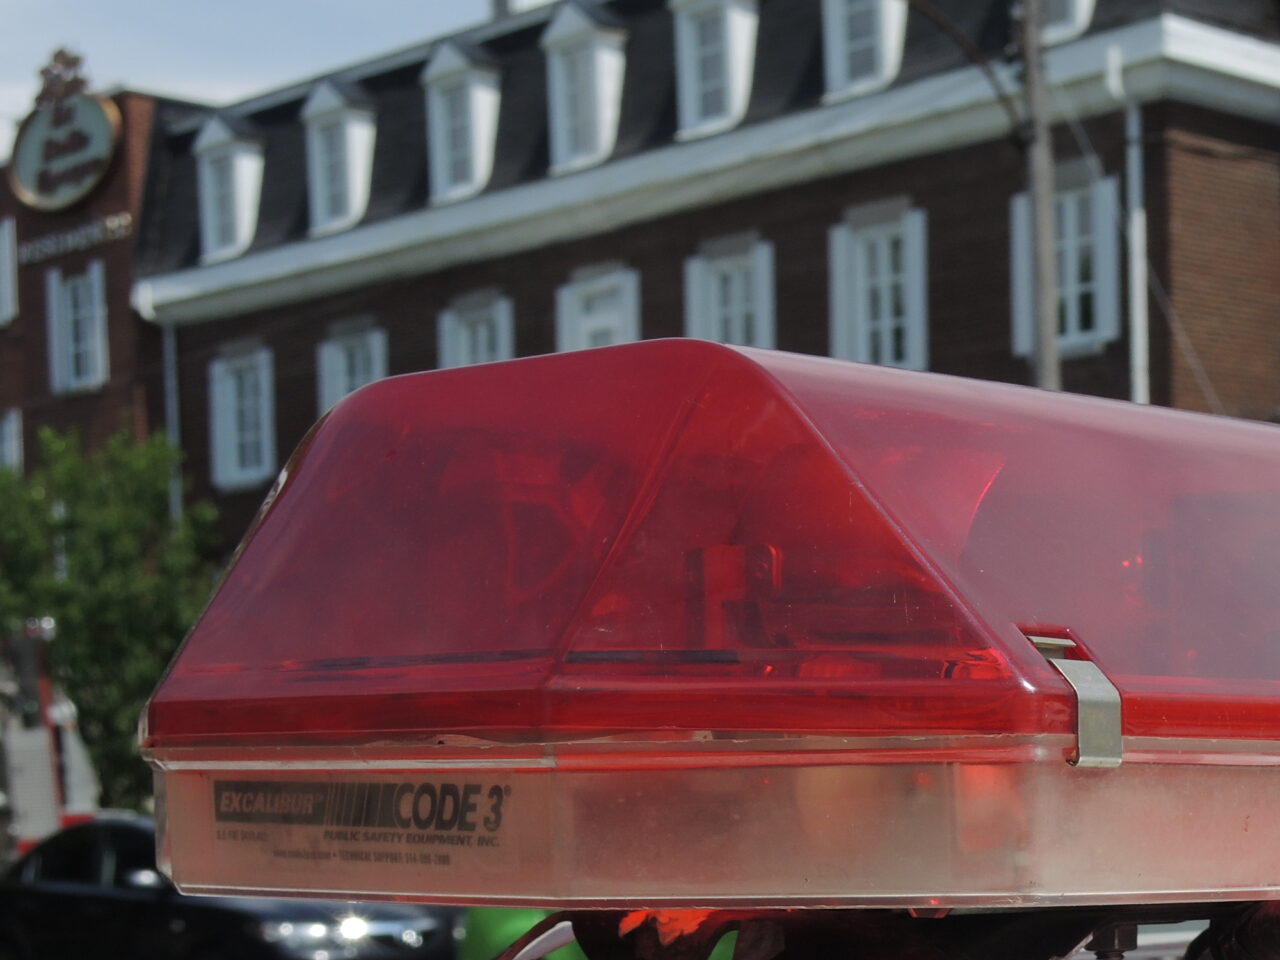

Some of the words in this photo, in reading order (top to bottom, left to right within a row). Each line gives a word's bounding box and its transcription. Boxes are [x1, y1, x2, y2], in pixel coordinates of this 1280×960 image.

[219, 791, 315, 816] EXCALIBUR
[394, 781, 483, 832] CODE
[323, 829, 361, 843] PUBLIC
[362, 831, 405, 845] SAFETY
[405, 832, 474, 848] EQUIPMENT,
[476, 835, 500, 848] INC.
